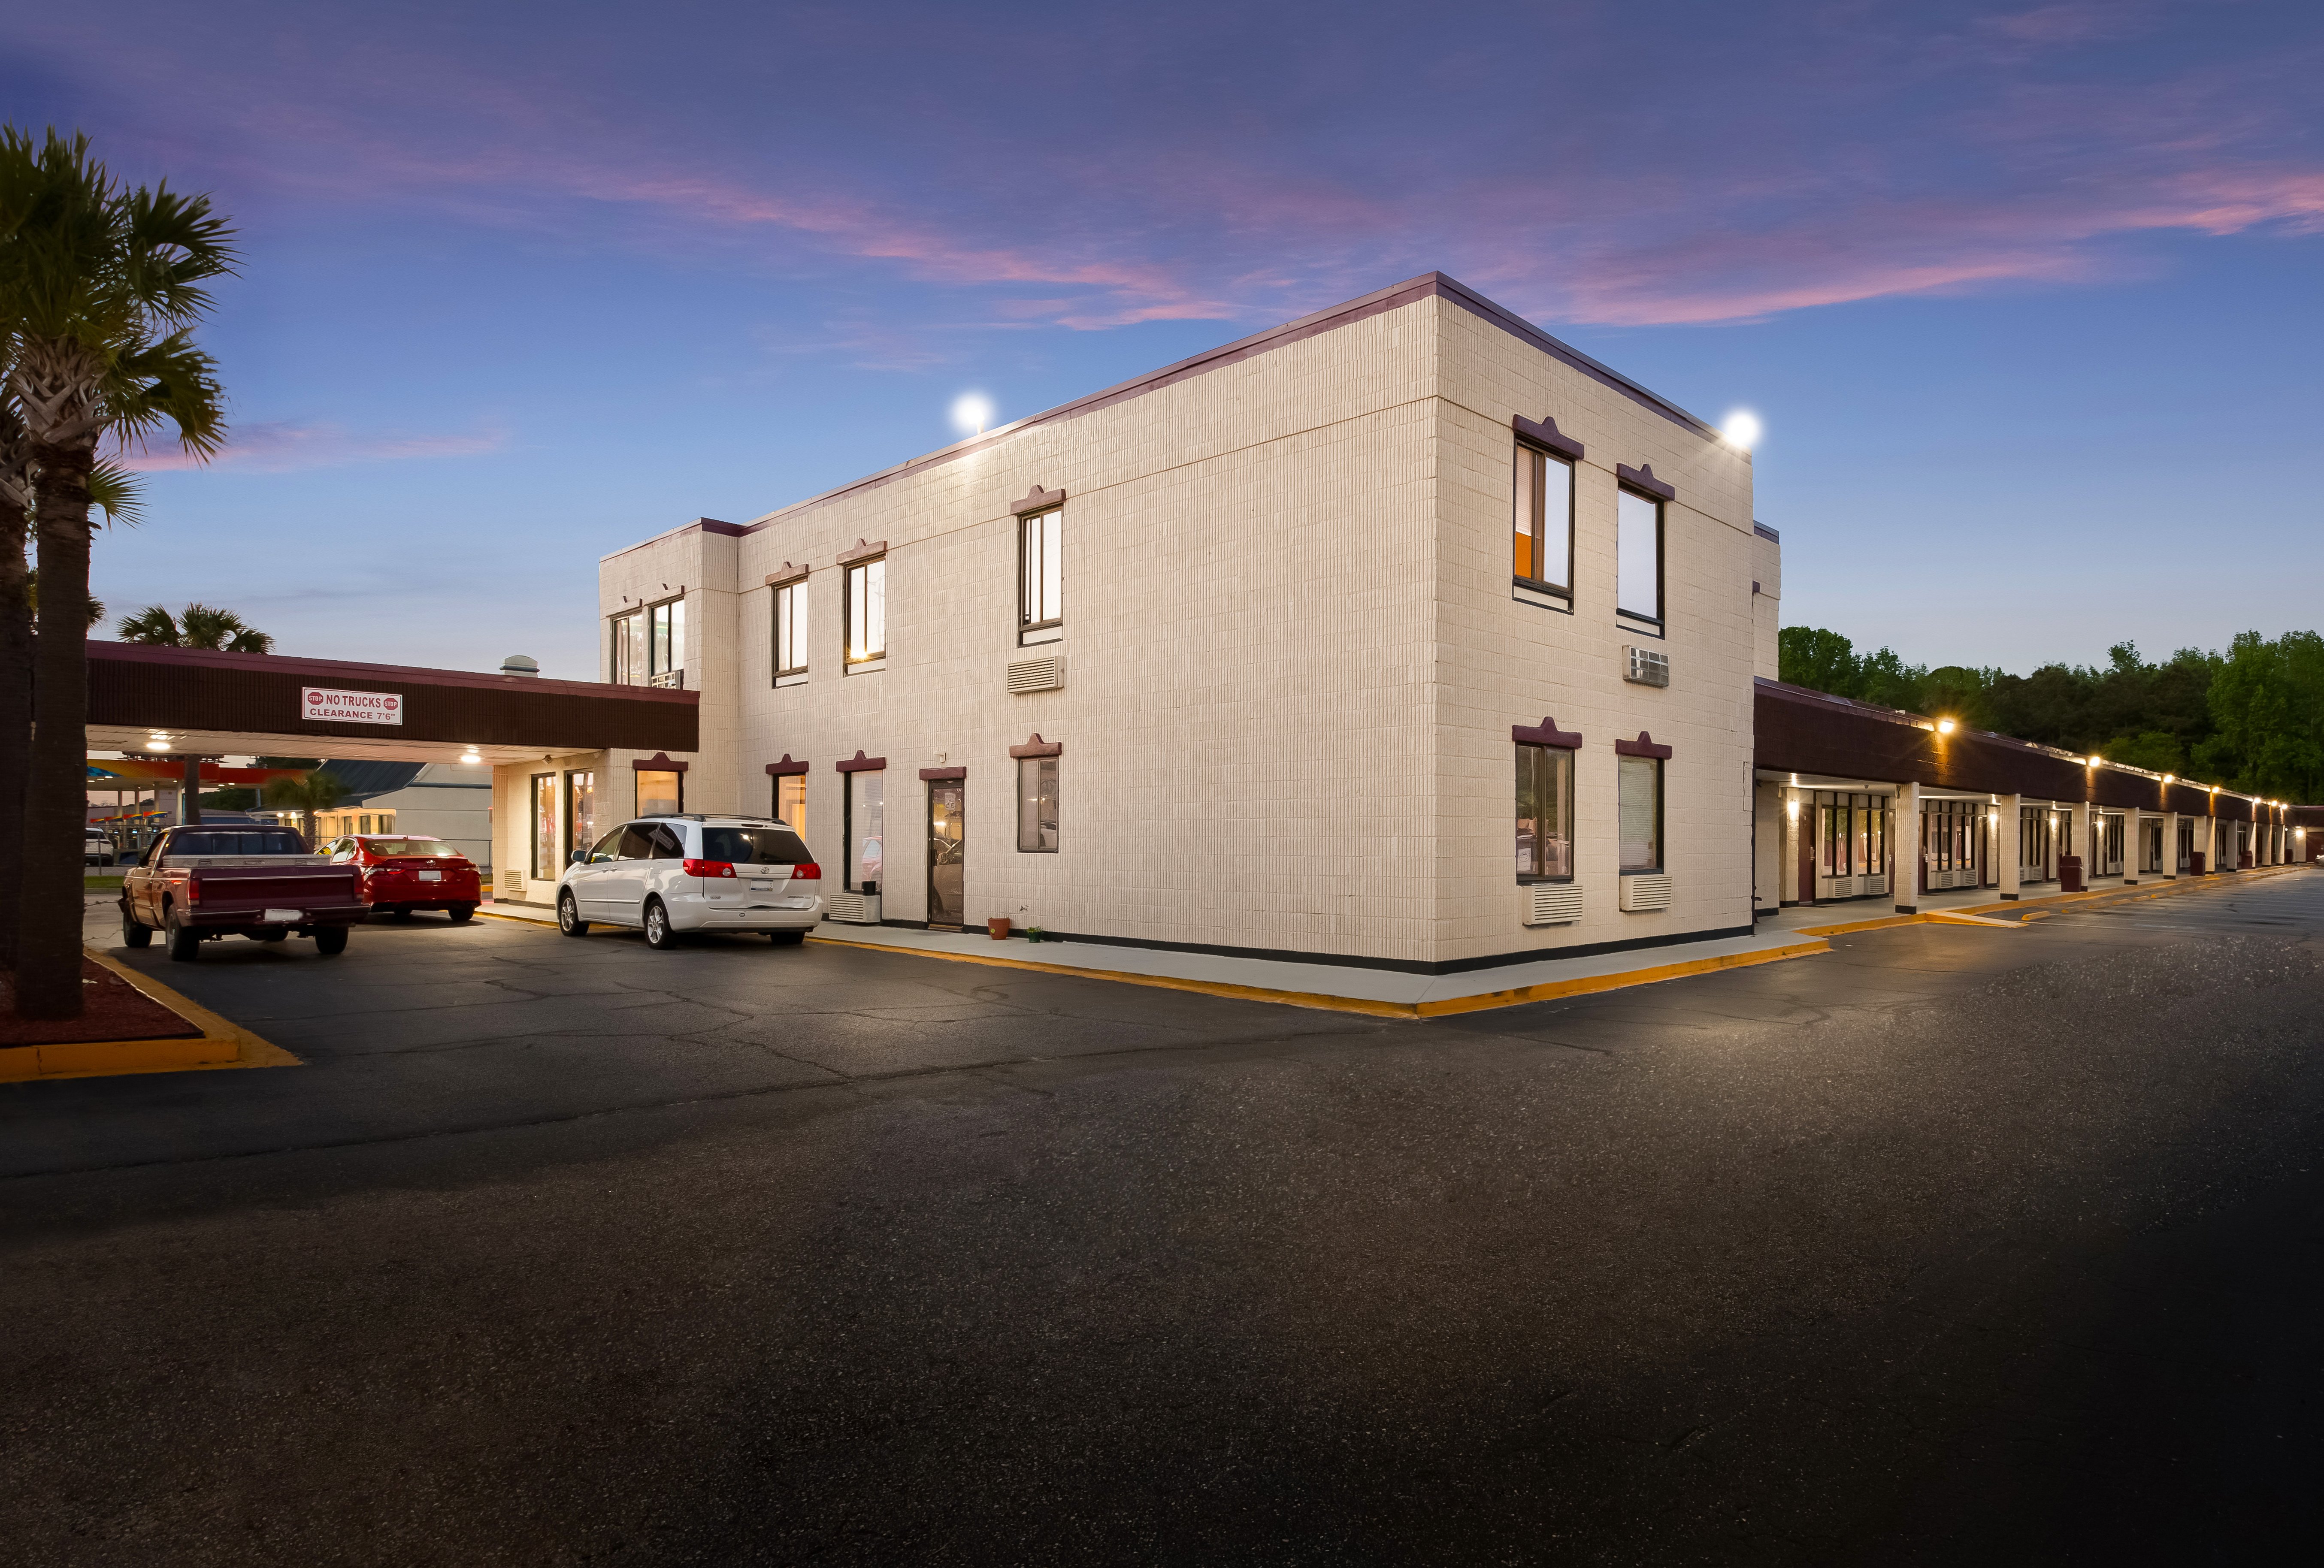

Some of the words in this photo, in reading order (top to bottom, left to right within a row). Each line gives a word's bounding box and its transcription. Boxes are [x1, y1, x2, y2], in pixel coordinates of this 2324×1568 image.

[327, 695, 340, 705] NO
[342, 695, 381, 708] TRUCKS
[310, 708, 373, 719] CLEARANCE
